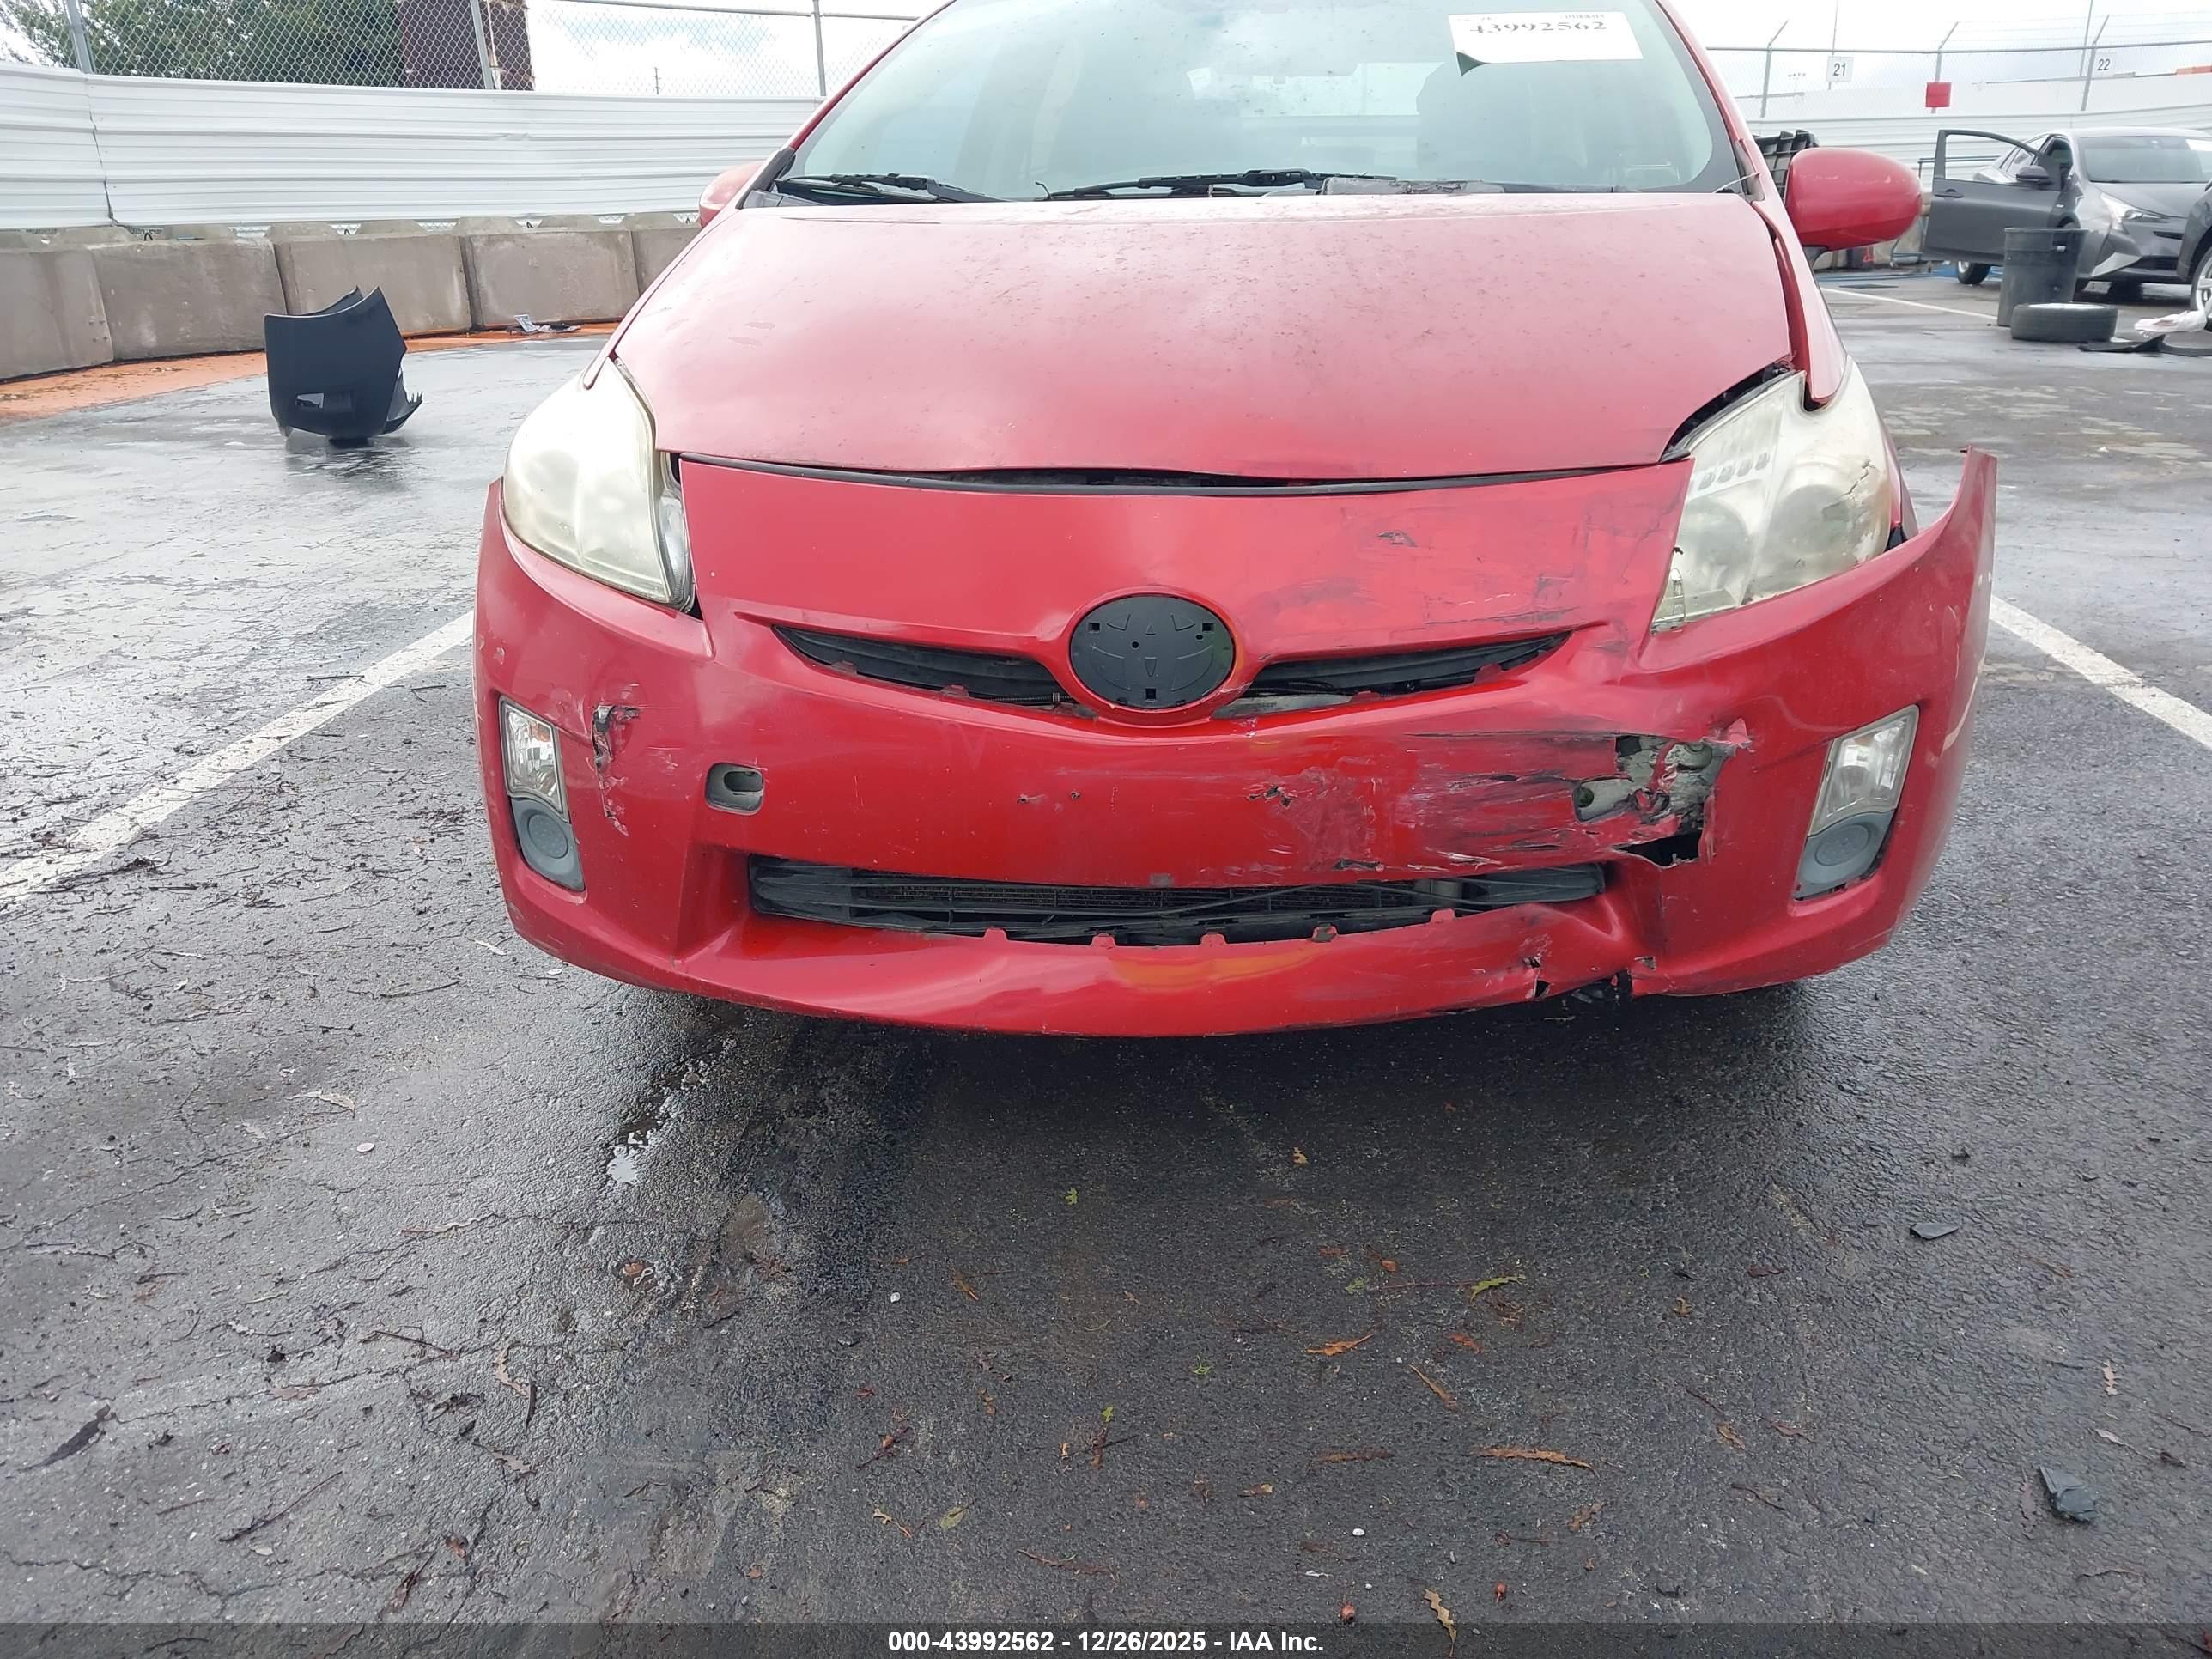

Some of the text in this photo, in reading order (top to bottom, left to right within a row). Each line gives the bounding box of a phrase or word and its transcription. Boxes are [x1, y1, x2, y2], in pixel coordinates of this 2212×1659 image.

[1469, 21, 1607, 33] 43992562
[1832, 62, 1846, 76] 21
[2097, 58, 2111, 70] 22
